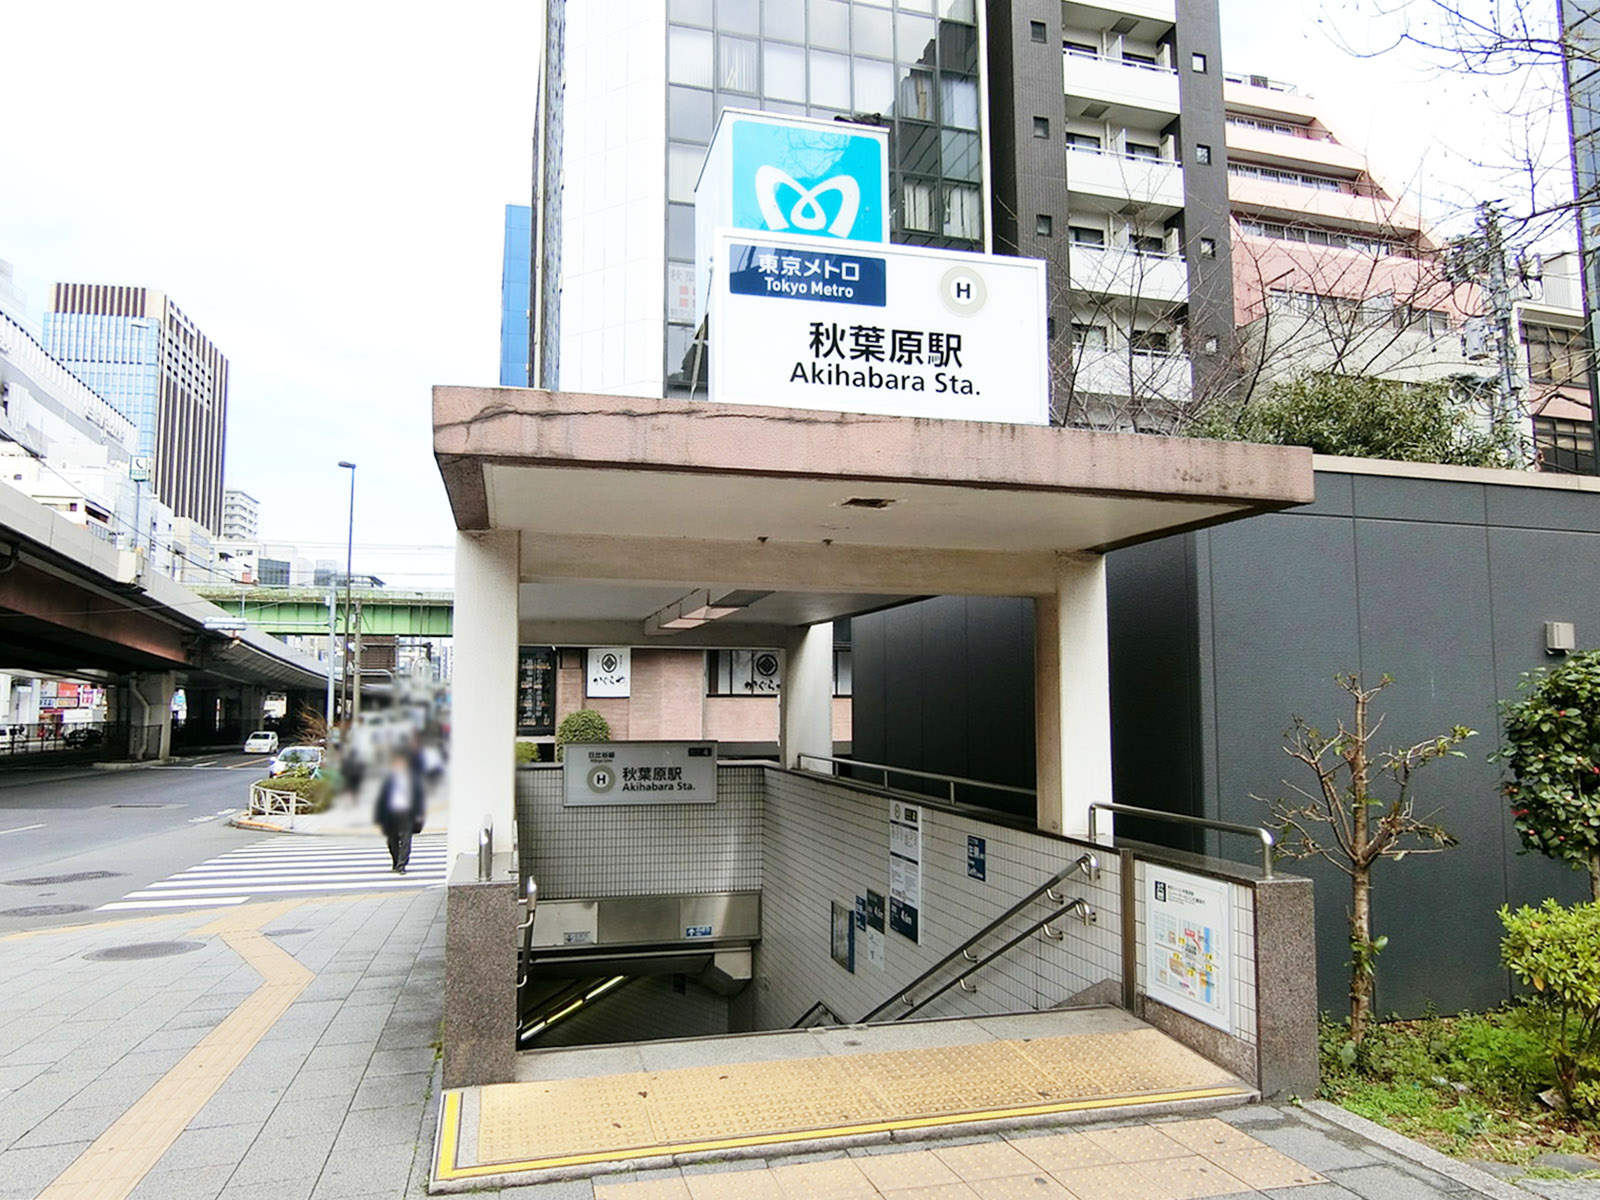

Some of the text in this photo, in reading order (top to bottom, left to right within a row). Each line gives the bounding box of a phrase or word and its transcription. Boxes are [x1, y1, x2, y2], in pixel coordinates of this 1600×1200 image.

[758, 254, 860, 281] 東京メトロ
[765, 278, 854, 299] Tokyo Metro
[955, 282, 971, 300] H
[809, 322, 963, 369] 秋葉原駅
[790, 362, 981, 397] Akihabara Sta.
[596, 774, 606, 784] H
[622, 767, 682, 781] 秋葉原駅
[622, 782, 696, 792] Akihabara Sta.
